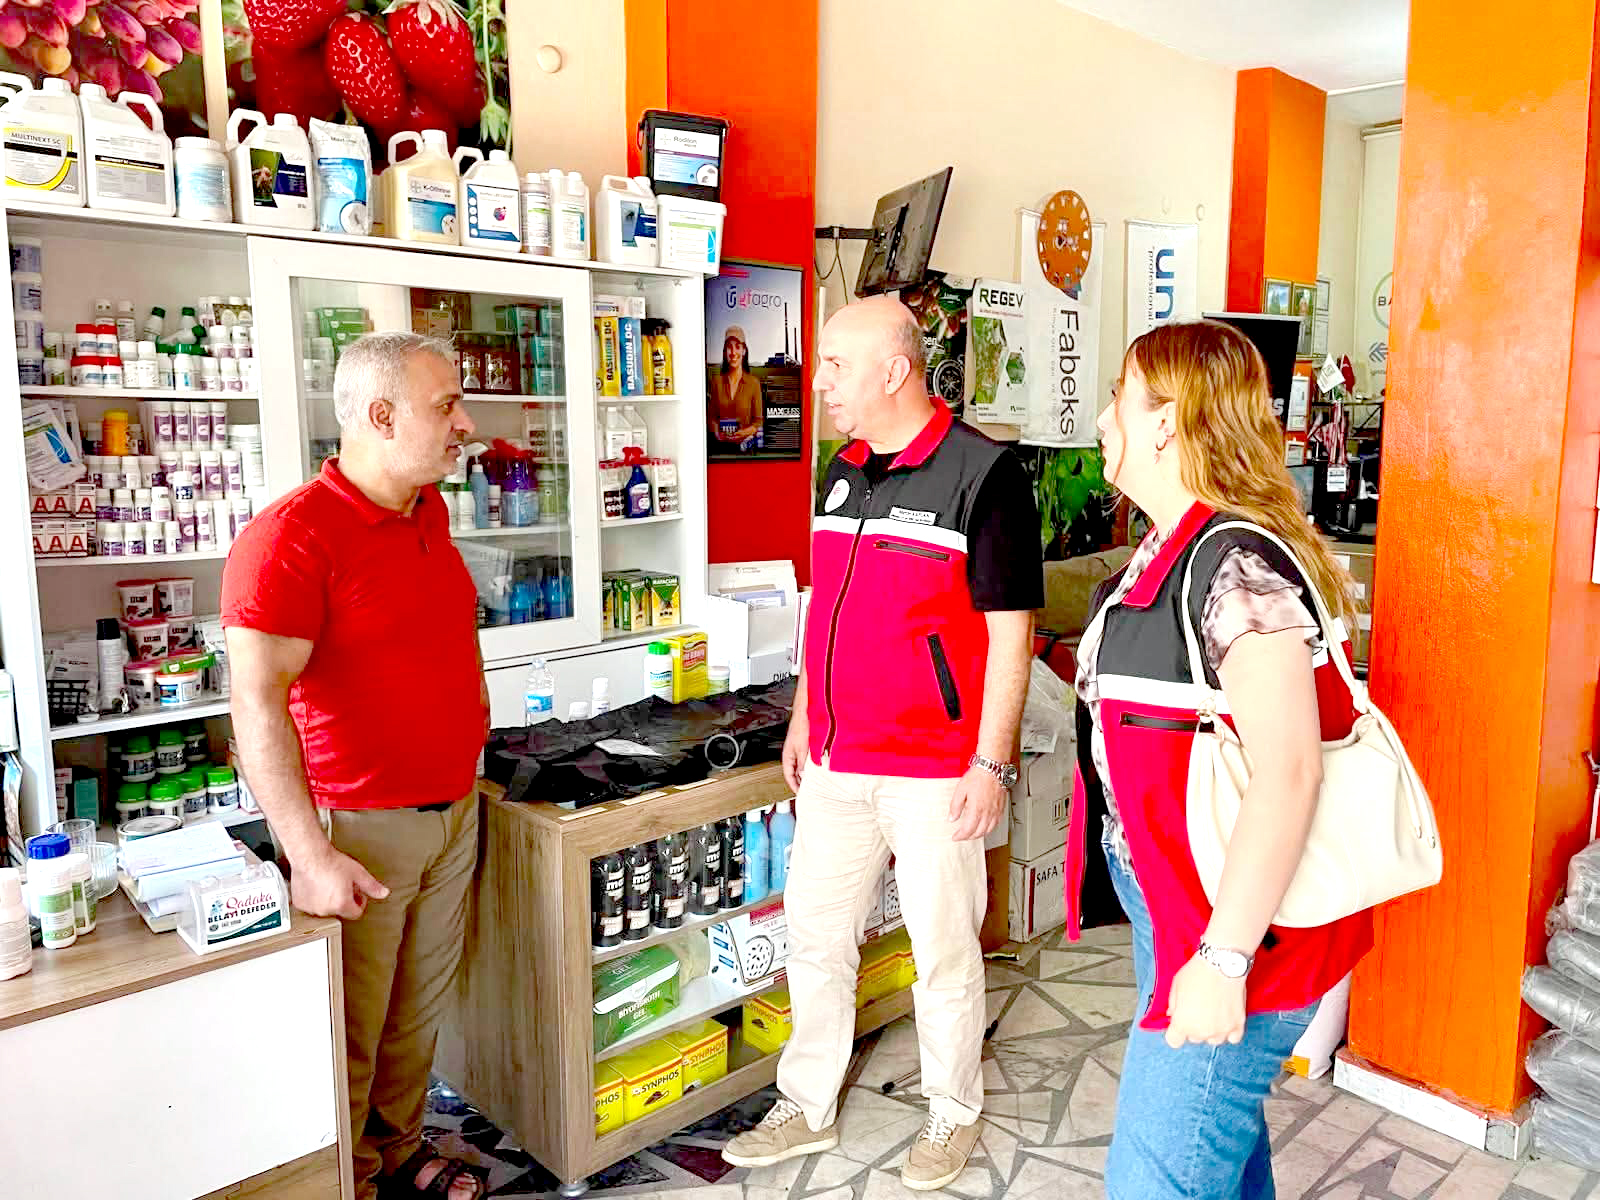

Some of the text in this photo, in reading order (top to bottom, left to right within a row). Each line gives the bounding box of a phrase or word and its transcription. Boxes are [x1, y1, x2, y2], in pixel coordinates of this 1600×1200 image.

[11, 132, 51, 144] MULTINEXT
[979, 287, 1024, 308] REGEV
[624, 322, 635, 391] BASUDIN DC
[1059, 308, 1081, 436] Fabeks
[1036, 865, 1058, 885] SAFA
[240, 901, 277, 916] DEFEDER
[689, 1040, 727, 1065] SYNPHOS
[641, 1069, 680, 1094] SYNPHOS
[595, 1091, 620, 1108] PHOS
